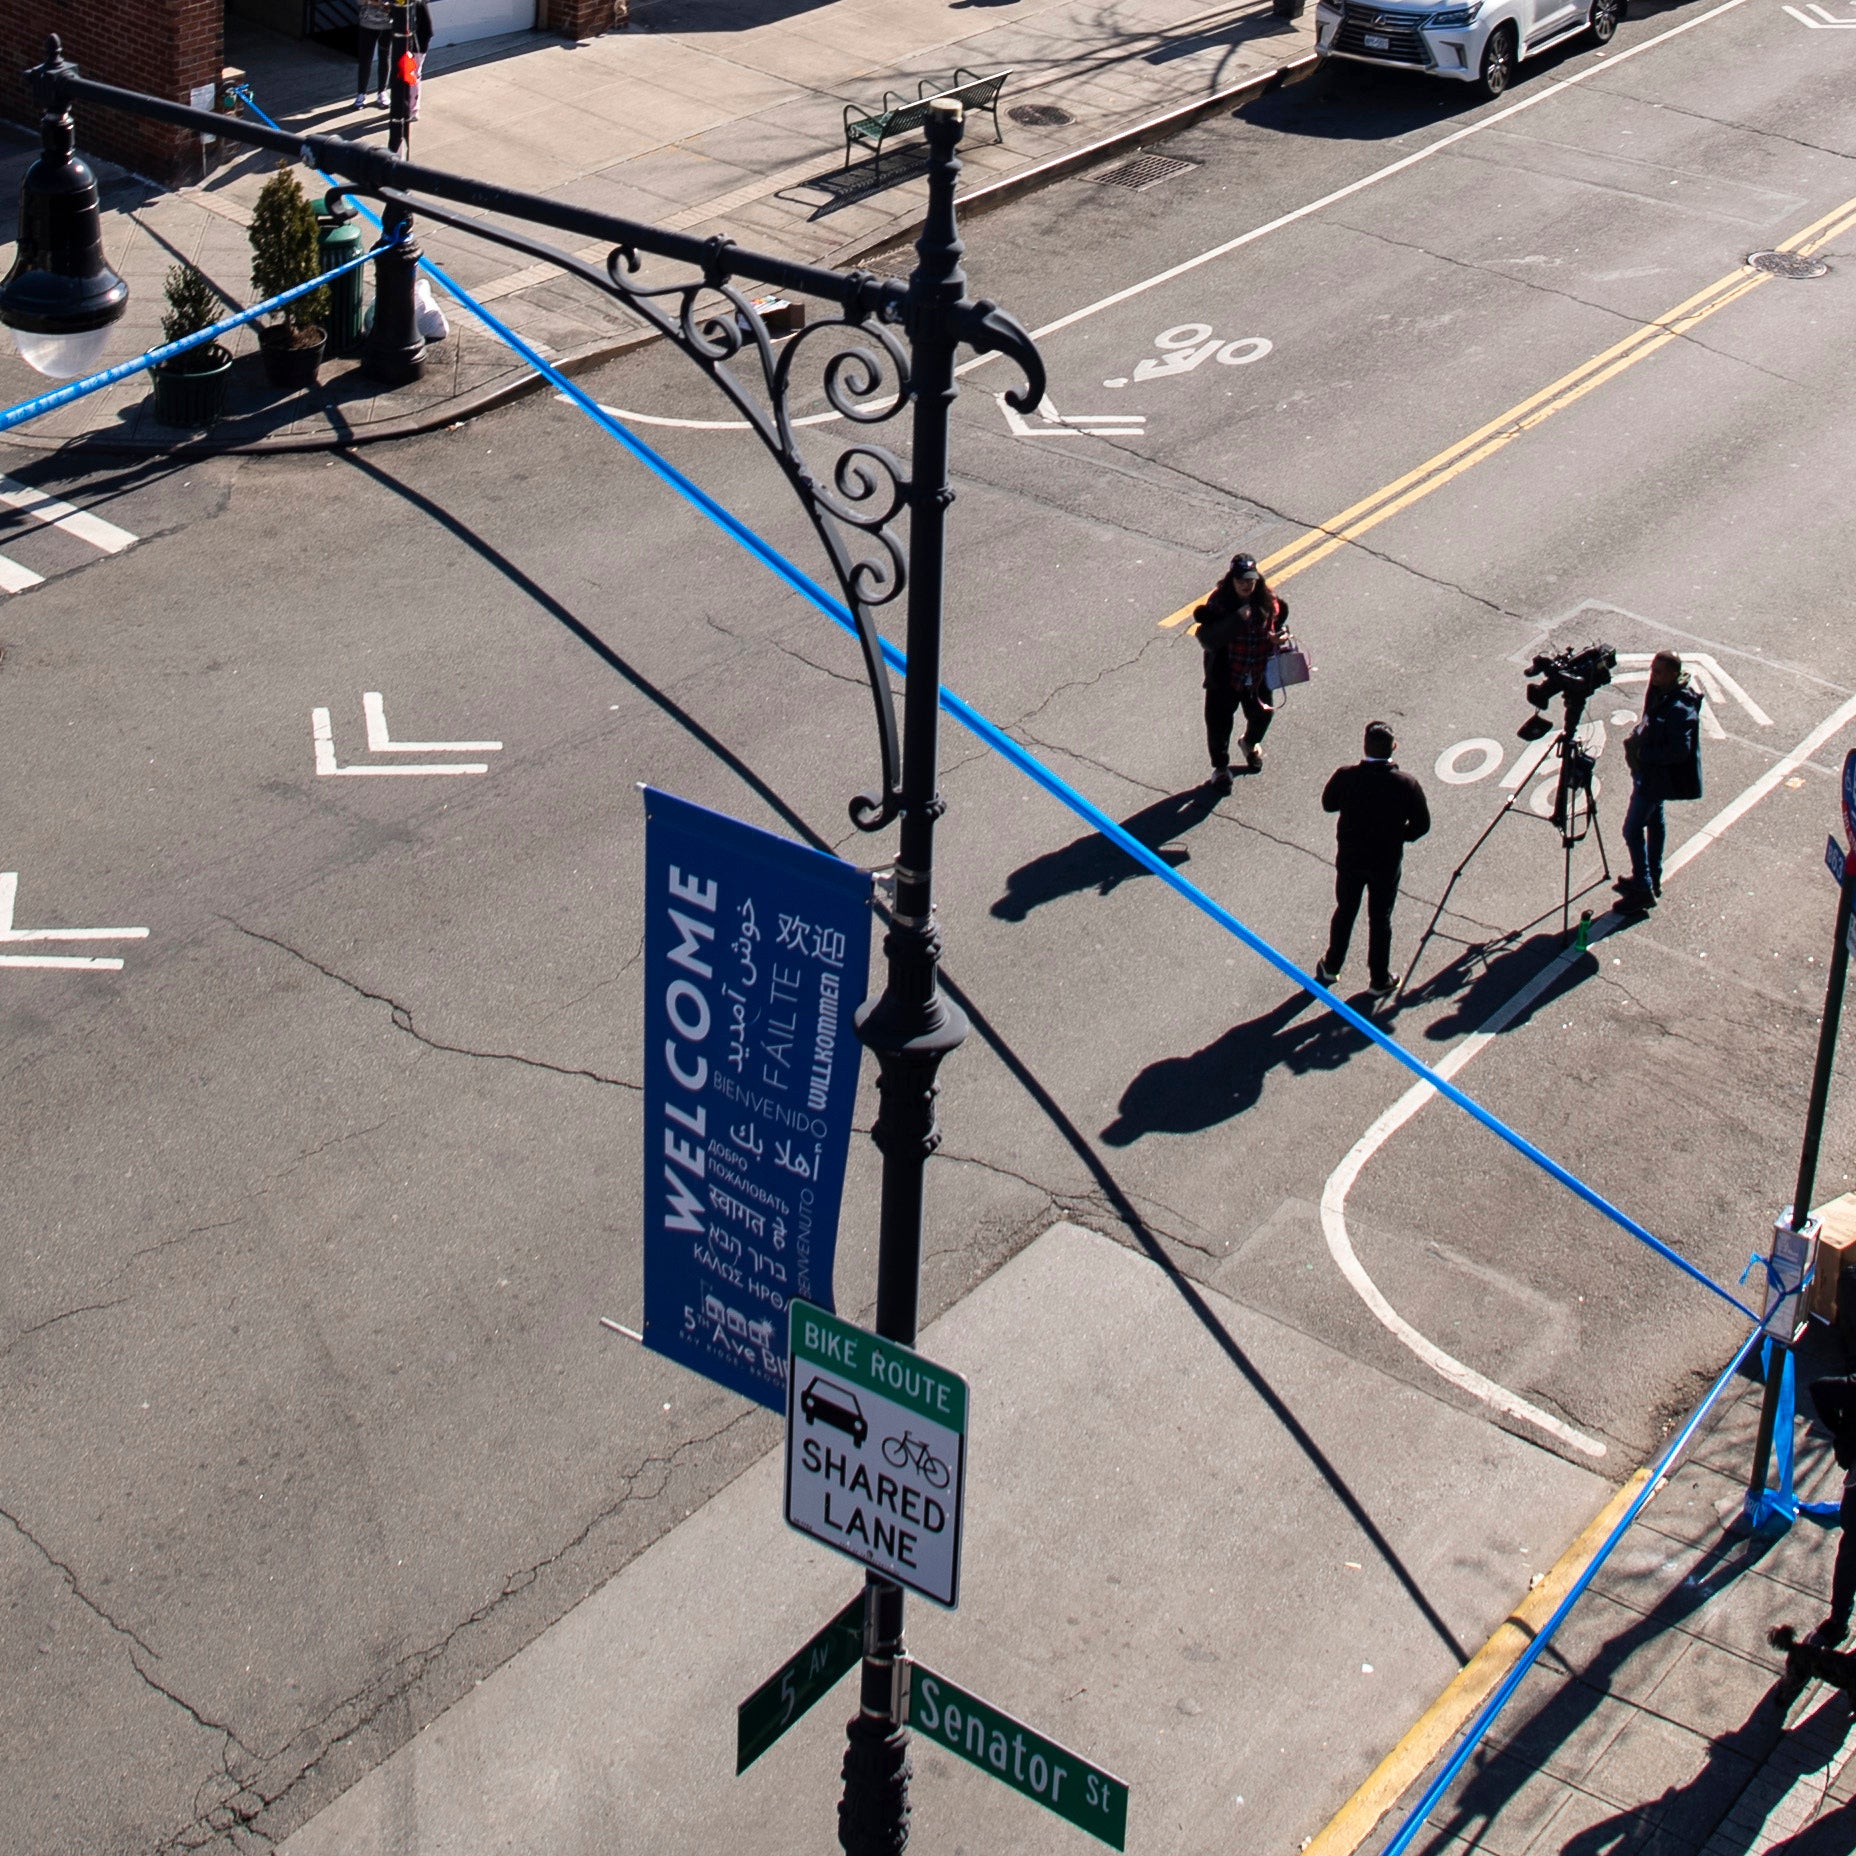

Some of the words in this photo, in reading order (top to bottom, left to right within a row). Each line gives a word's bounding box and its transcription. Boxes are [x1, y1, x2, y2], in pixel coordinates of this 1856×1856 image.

[730, 897, 762, 987] خوش
[775, 912, 847, 968] 欢迎
[664, 863, 719, 1234] WELCOME
[760, 962, 801, 1091] FÁILTE
[712, 1070, 828, 1140] BIENVENIDO
[707, 1138, 748, 1172] ДОБРО
[707, 1158, 790, 1217] ПОЖАЛОВАТЬ
[707, 1182, 766, 1240] स्वागत
[747, 1245, 787, 1283] ברוך
[712, 1322, 756, 1364] Ave
[804, 1320, 858, 1369] BIKE
[870, 1351, 951, 1415] ROUTE
[801, 1436, 947, 1534] SHARED
[823, 1491, 918, 1570] LANE
[779, 1669, 797, 1728] 5
[808, 1642, 829, 1681] Av
[919, 1677, 1069, 1803] Senator
[1085, 1773, 1113, 1814] St
